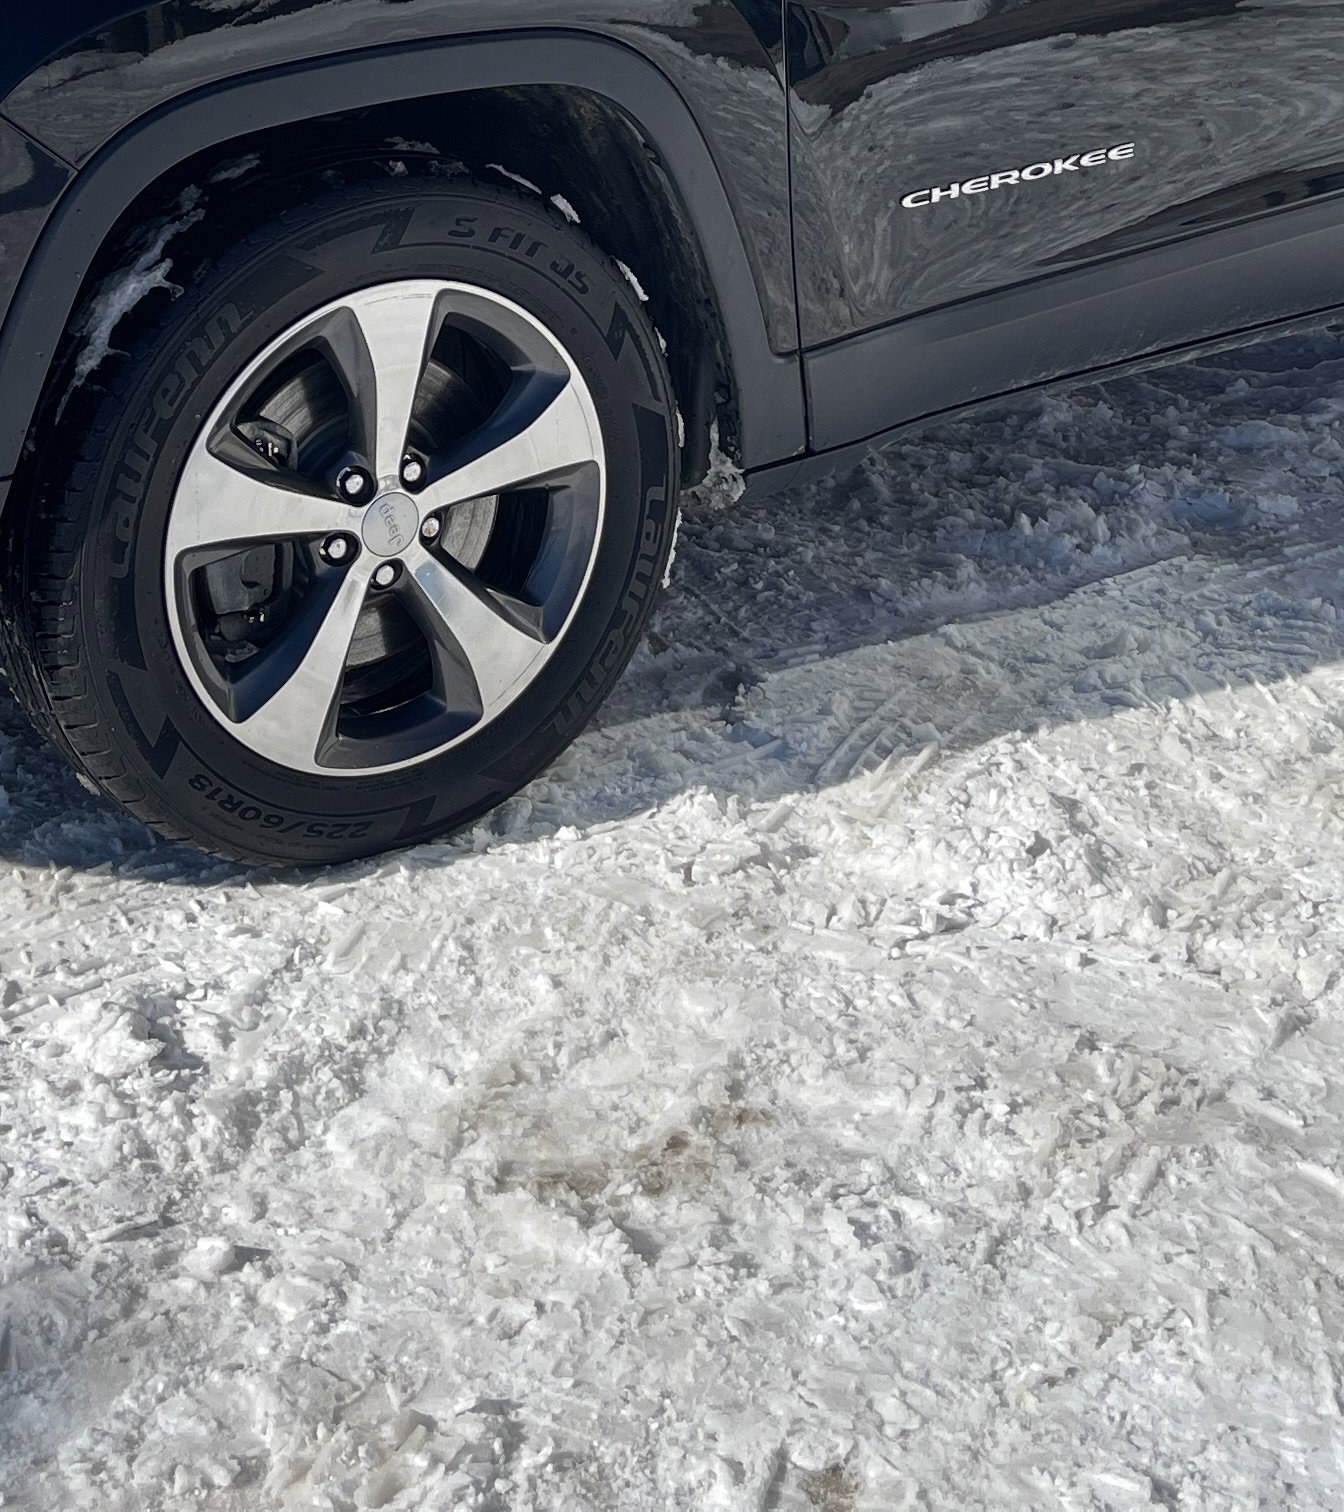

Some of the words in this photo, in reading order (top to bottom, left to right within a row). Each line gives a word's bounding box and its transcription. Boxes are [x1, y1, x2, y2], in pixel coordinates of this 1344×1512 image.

[901, 142, 1135, 209] CHEROKEE
[378, 502, 406, 547] Jeep
[186, 772, 374, 840] 225/60R18
